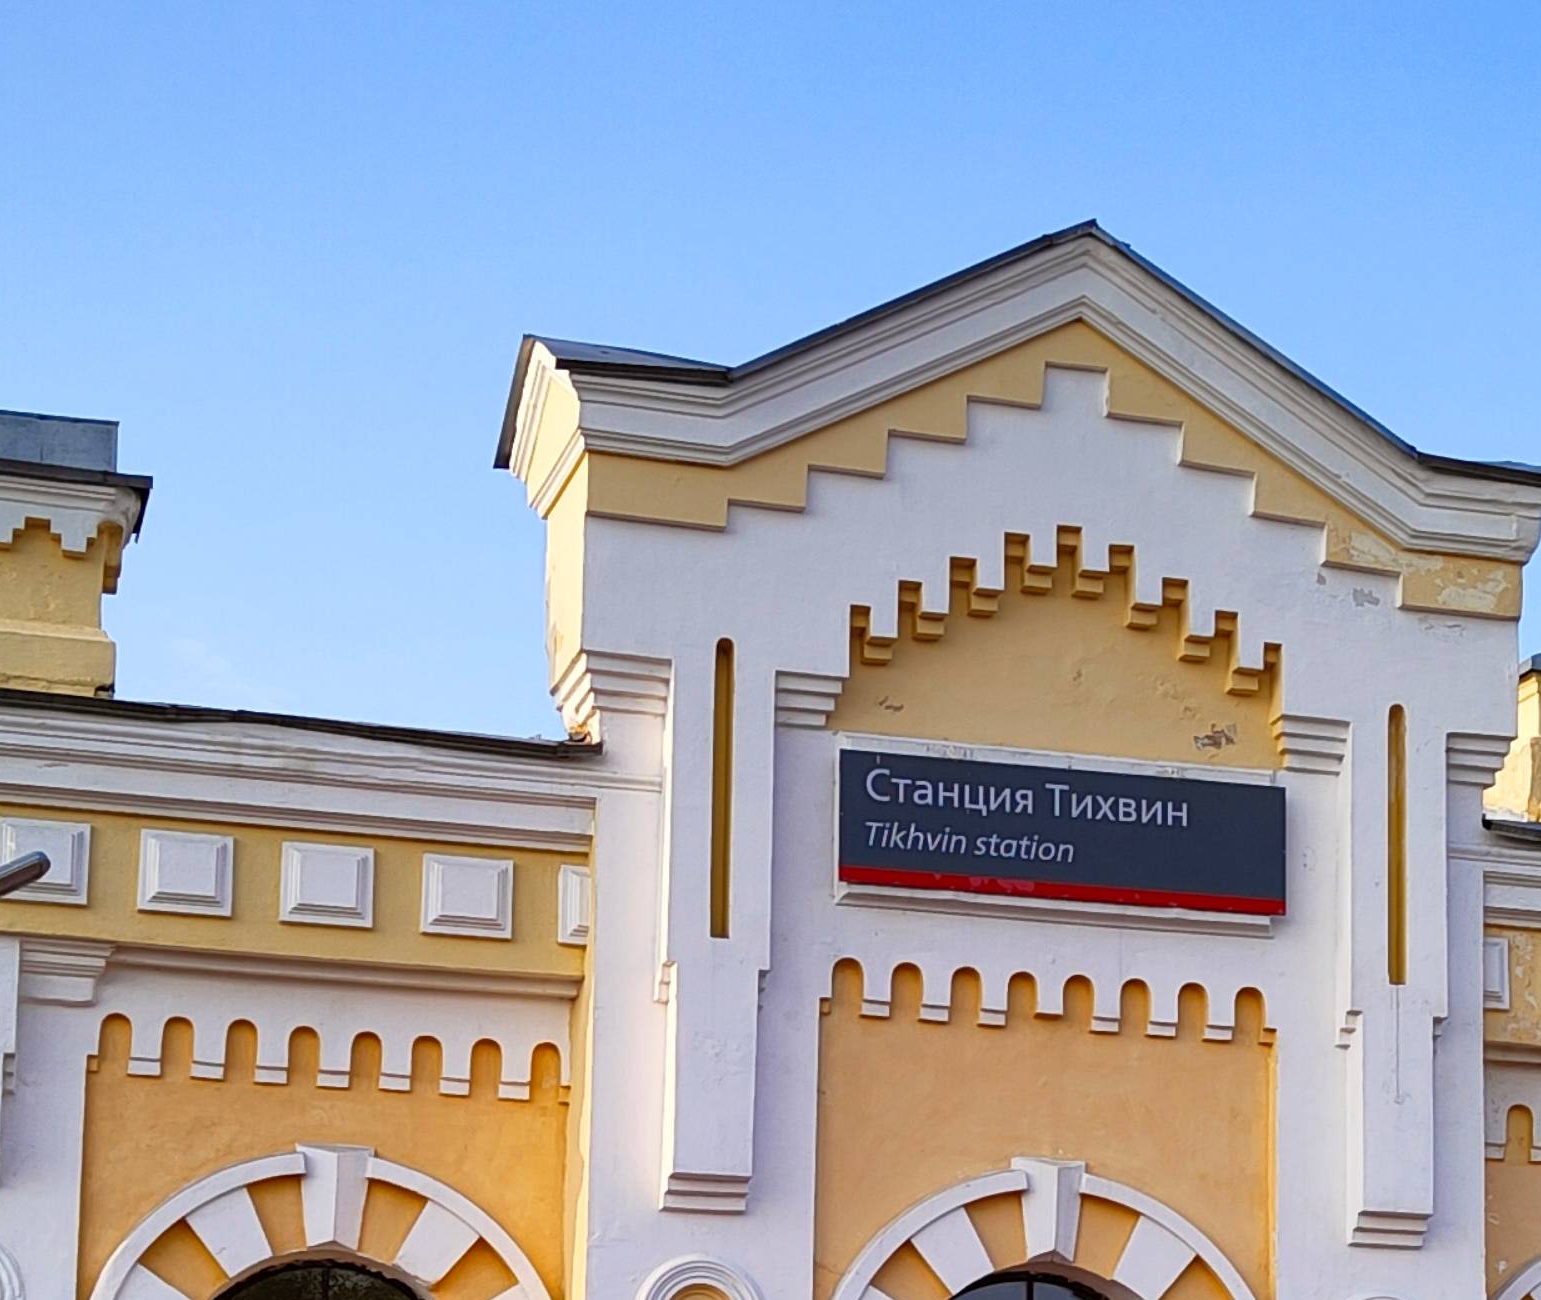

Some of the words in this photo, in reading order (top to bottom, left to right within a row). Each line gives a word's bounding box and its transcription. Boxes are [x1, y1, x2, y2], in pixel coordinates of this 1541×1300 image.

[865, 768, 1033, 816] Станция
[1044, 783, 1188, 827] Тихвин
[865, 821, 967, 854] Tikhvin
[973, 833, 1074, 863] station
